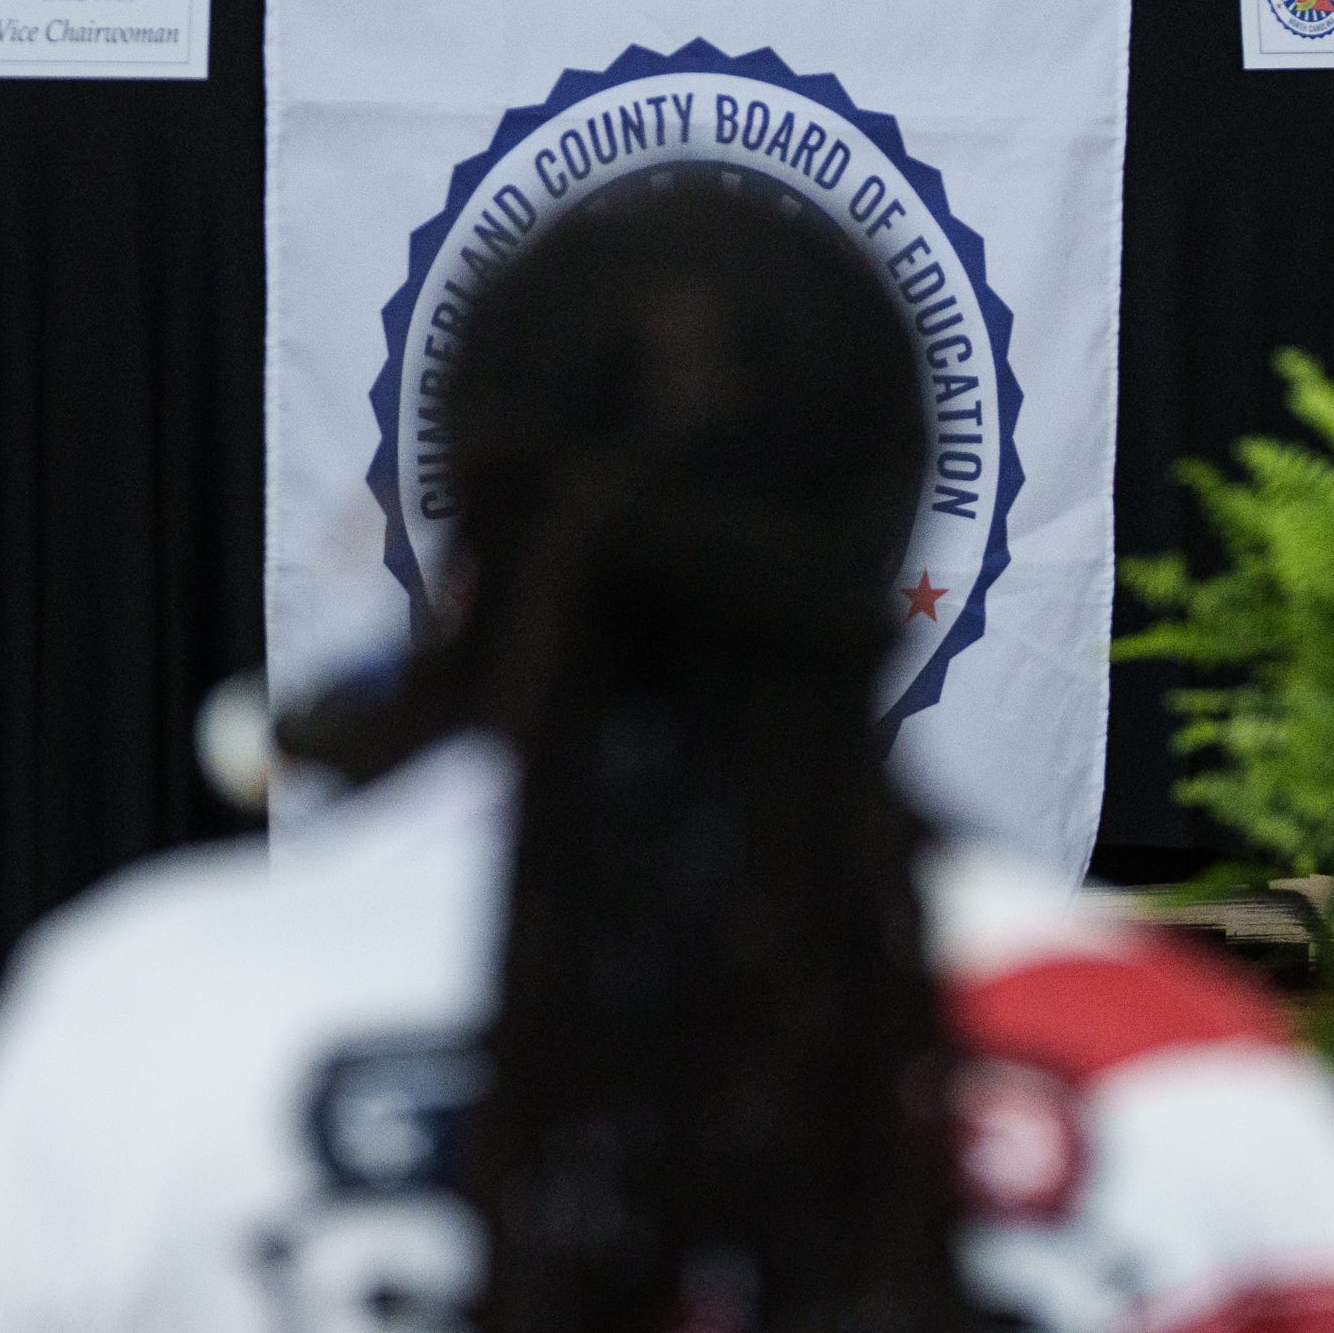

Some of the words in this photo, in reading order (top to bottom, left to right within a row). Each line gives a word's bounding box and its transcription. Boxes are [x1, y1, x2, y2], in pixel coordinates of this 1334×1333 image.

[45, 19, 179, 44] Chairwoman
[534, 92, 694, 199] COUNTY
[715, 93, 851, 191] BOARD
[849, 175, 906, 240] OF
[883, 235, 984, 521] EDUCATION
